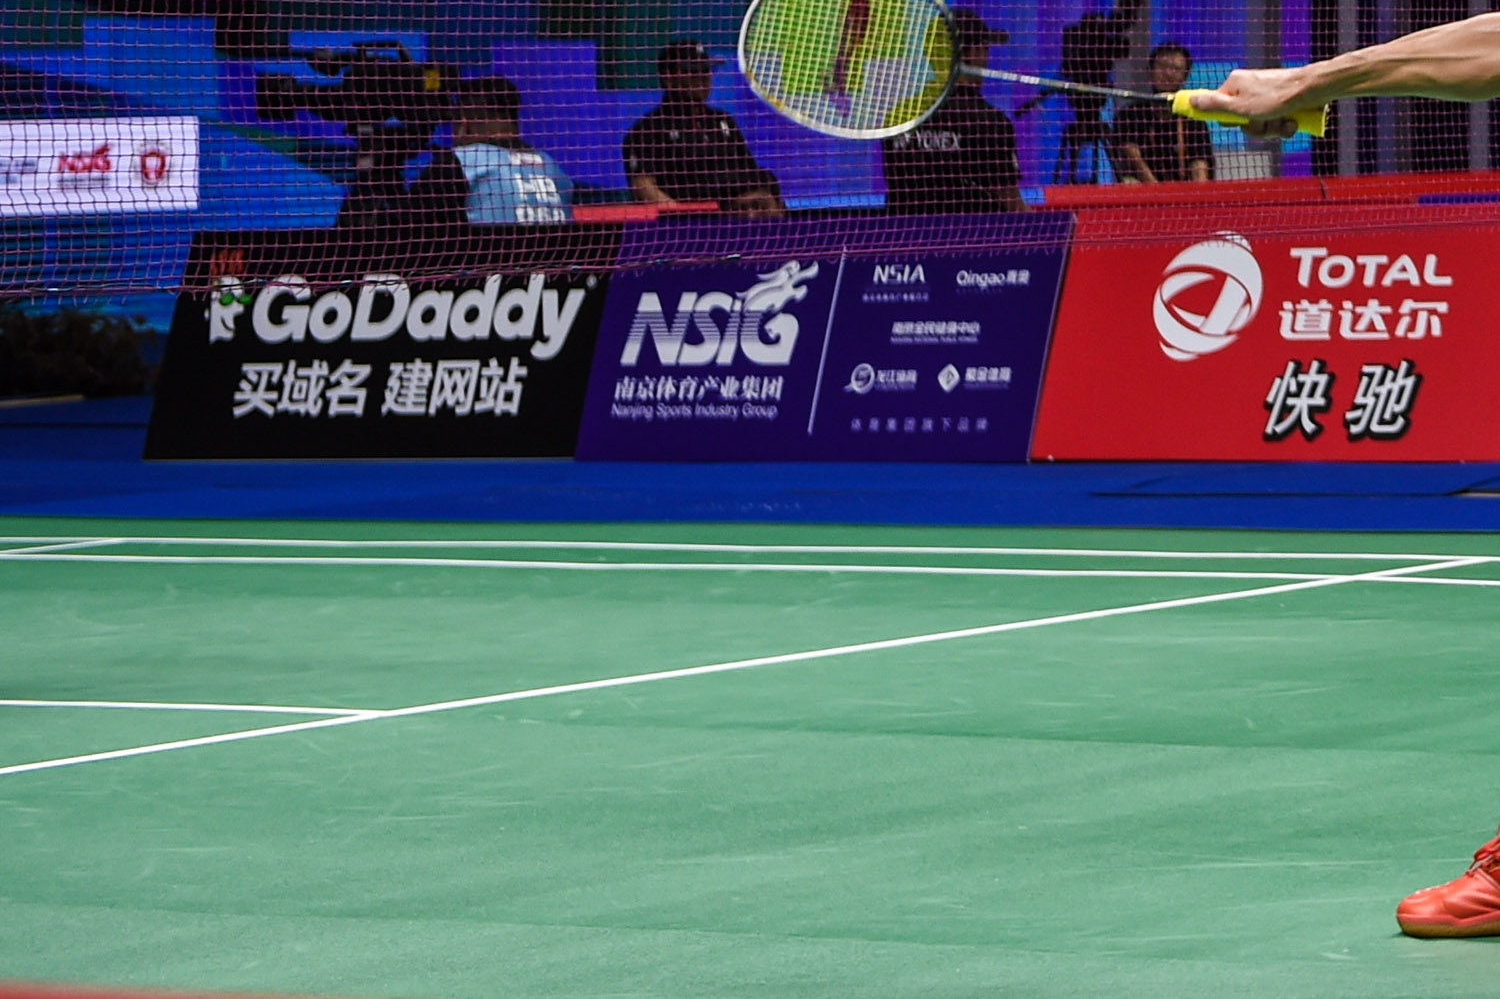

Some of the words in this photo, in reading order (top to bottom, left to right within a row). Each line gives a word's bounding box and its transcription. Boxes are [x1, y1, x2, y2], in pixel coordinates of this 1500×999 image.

[915, 129, 960, 151] YONEX
[872, 263, 926, 284] NSIA
[1289, 246, 1454, 289] TOTAL
[252, 272, 585, 362] GoDaddy
[1278, 297, 1451, 341] 道达尔
[232, 358, 373, 418] 买域名
[380, 356, 529, 416] 建网站
[613, 374, 784, 401] 南京体育产业集团
[611, 402, 654, 420] Nanjing
[656, 402, 692, 419] Sports
[694, 403, 738, 420] Industry
[742, 402, 778, 419] Group
